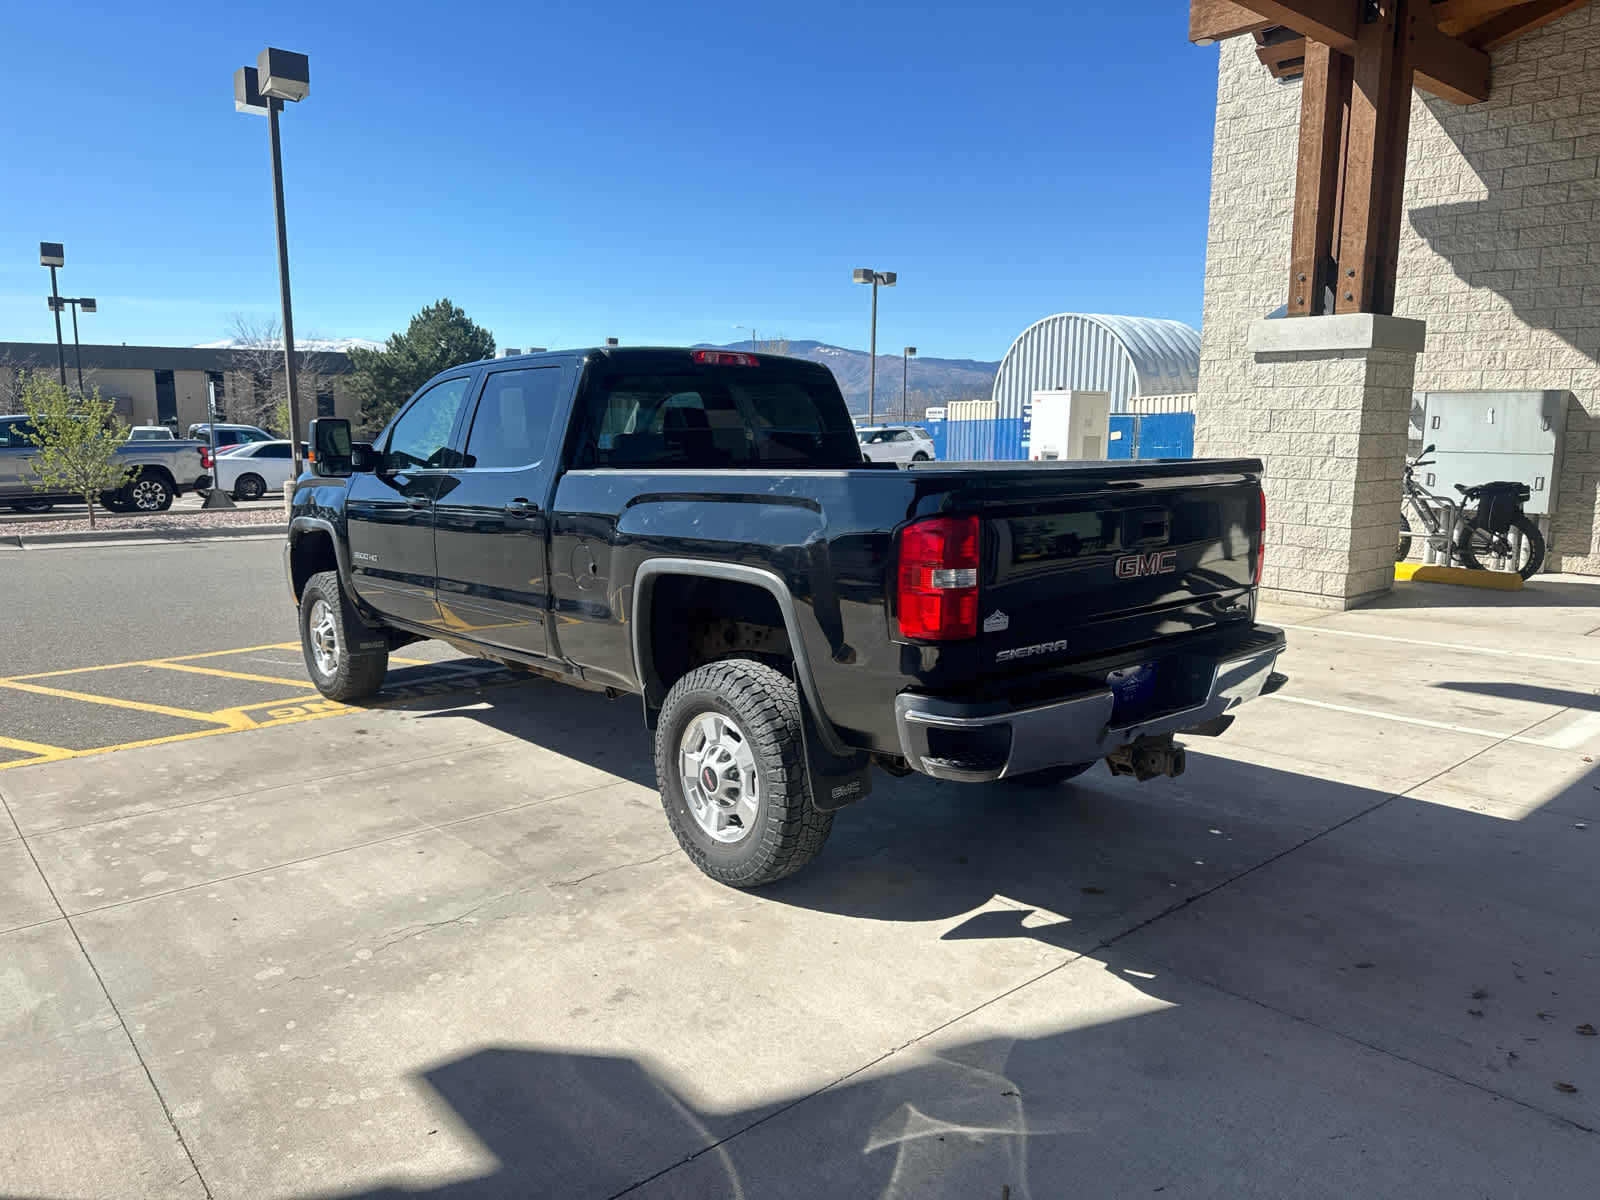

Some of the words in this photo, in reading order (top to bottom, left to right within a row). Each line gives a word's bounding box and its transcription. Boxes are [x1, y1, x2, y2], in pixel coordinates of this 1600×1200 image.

[1115, 550, 1177, 579] GMC
[994, 639, 1068, 664] SIERRA
[831, 781, 861, 799] GMC
